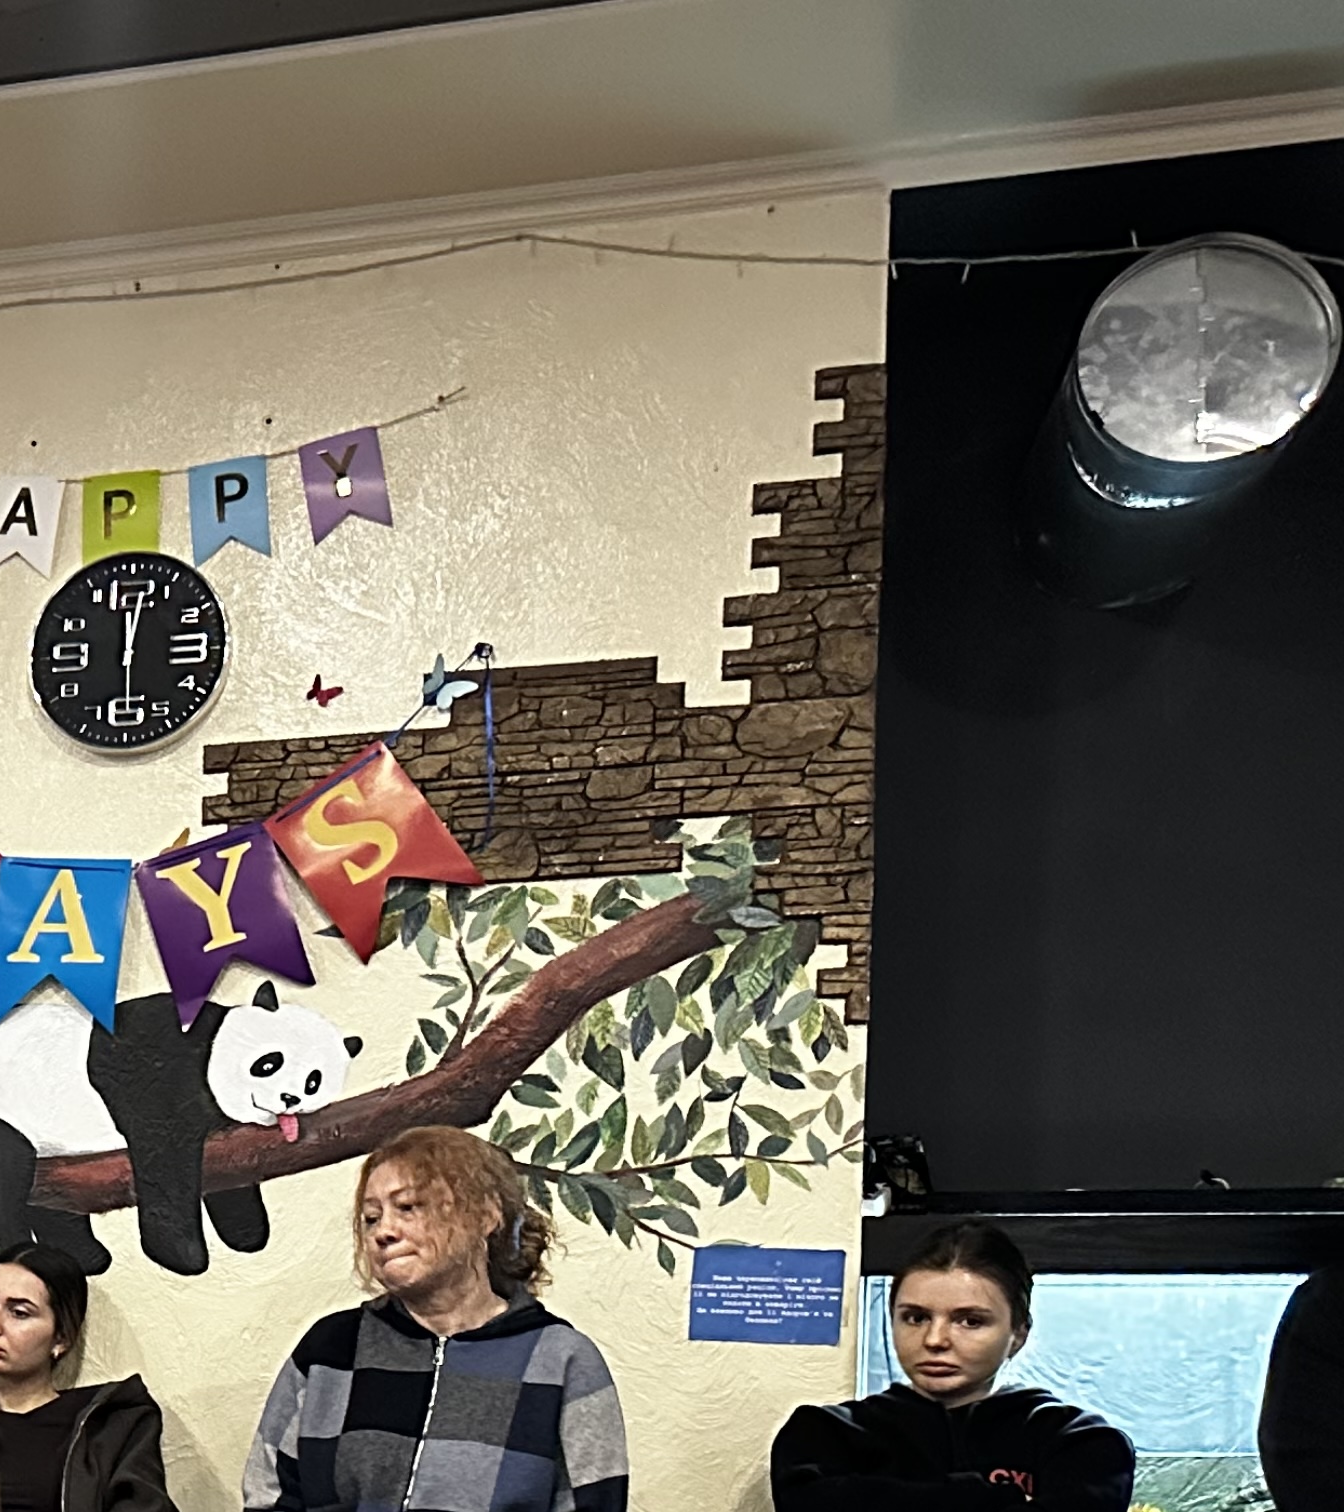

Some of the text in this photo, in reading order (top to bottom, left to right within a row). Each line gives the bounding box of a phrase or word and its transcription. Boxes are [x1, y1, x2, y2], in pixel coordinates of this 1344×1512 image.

[92, 589, 103, 603] 11
[109, 580, 156, 611] 12
[163, 585, 170, 600] 1
[181, 607, 200, 624] 2
[63, 618, 86, 632] 10
[168, 632, 208, 665] 3
[52, 642, 89, 673] 9
[61, 683, 79, 698] 8
[177, 675, 196, 690] 4
[84, 705, 102, 720] 7
[108, 694, 145, 727] 6
[151, 701, 170, 717] 5
[989, 1469, 1033, 1494] СХІ
